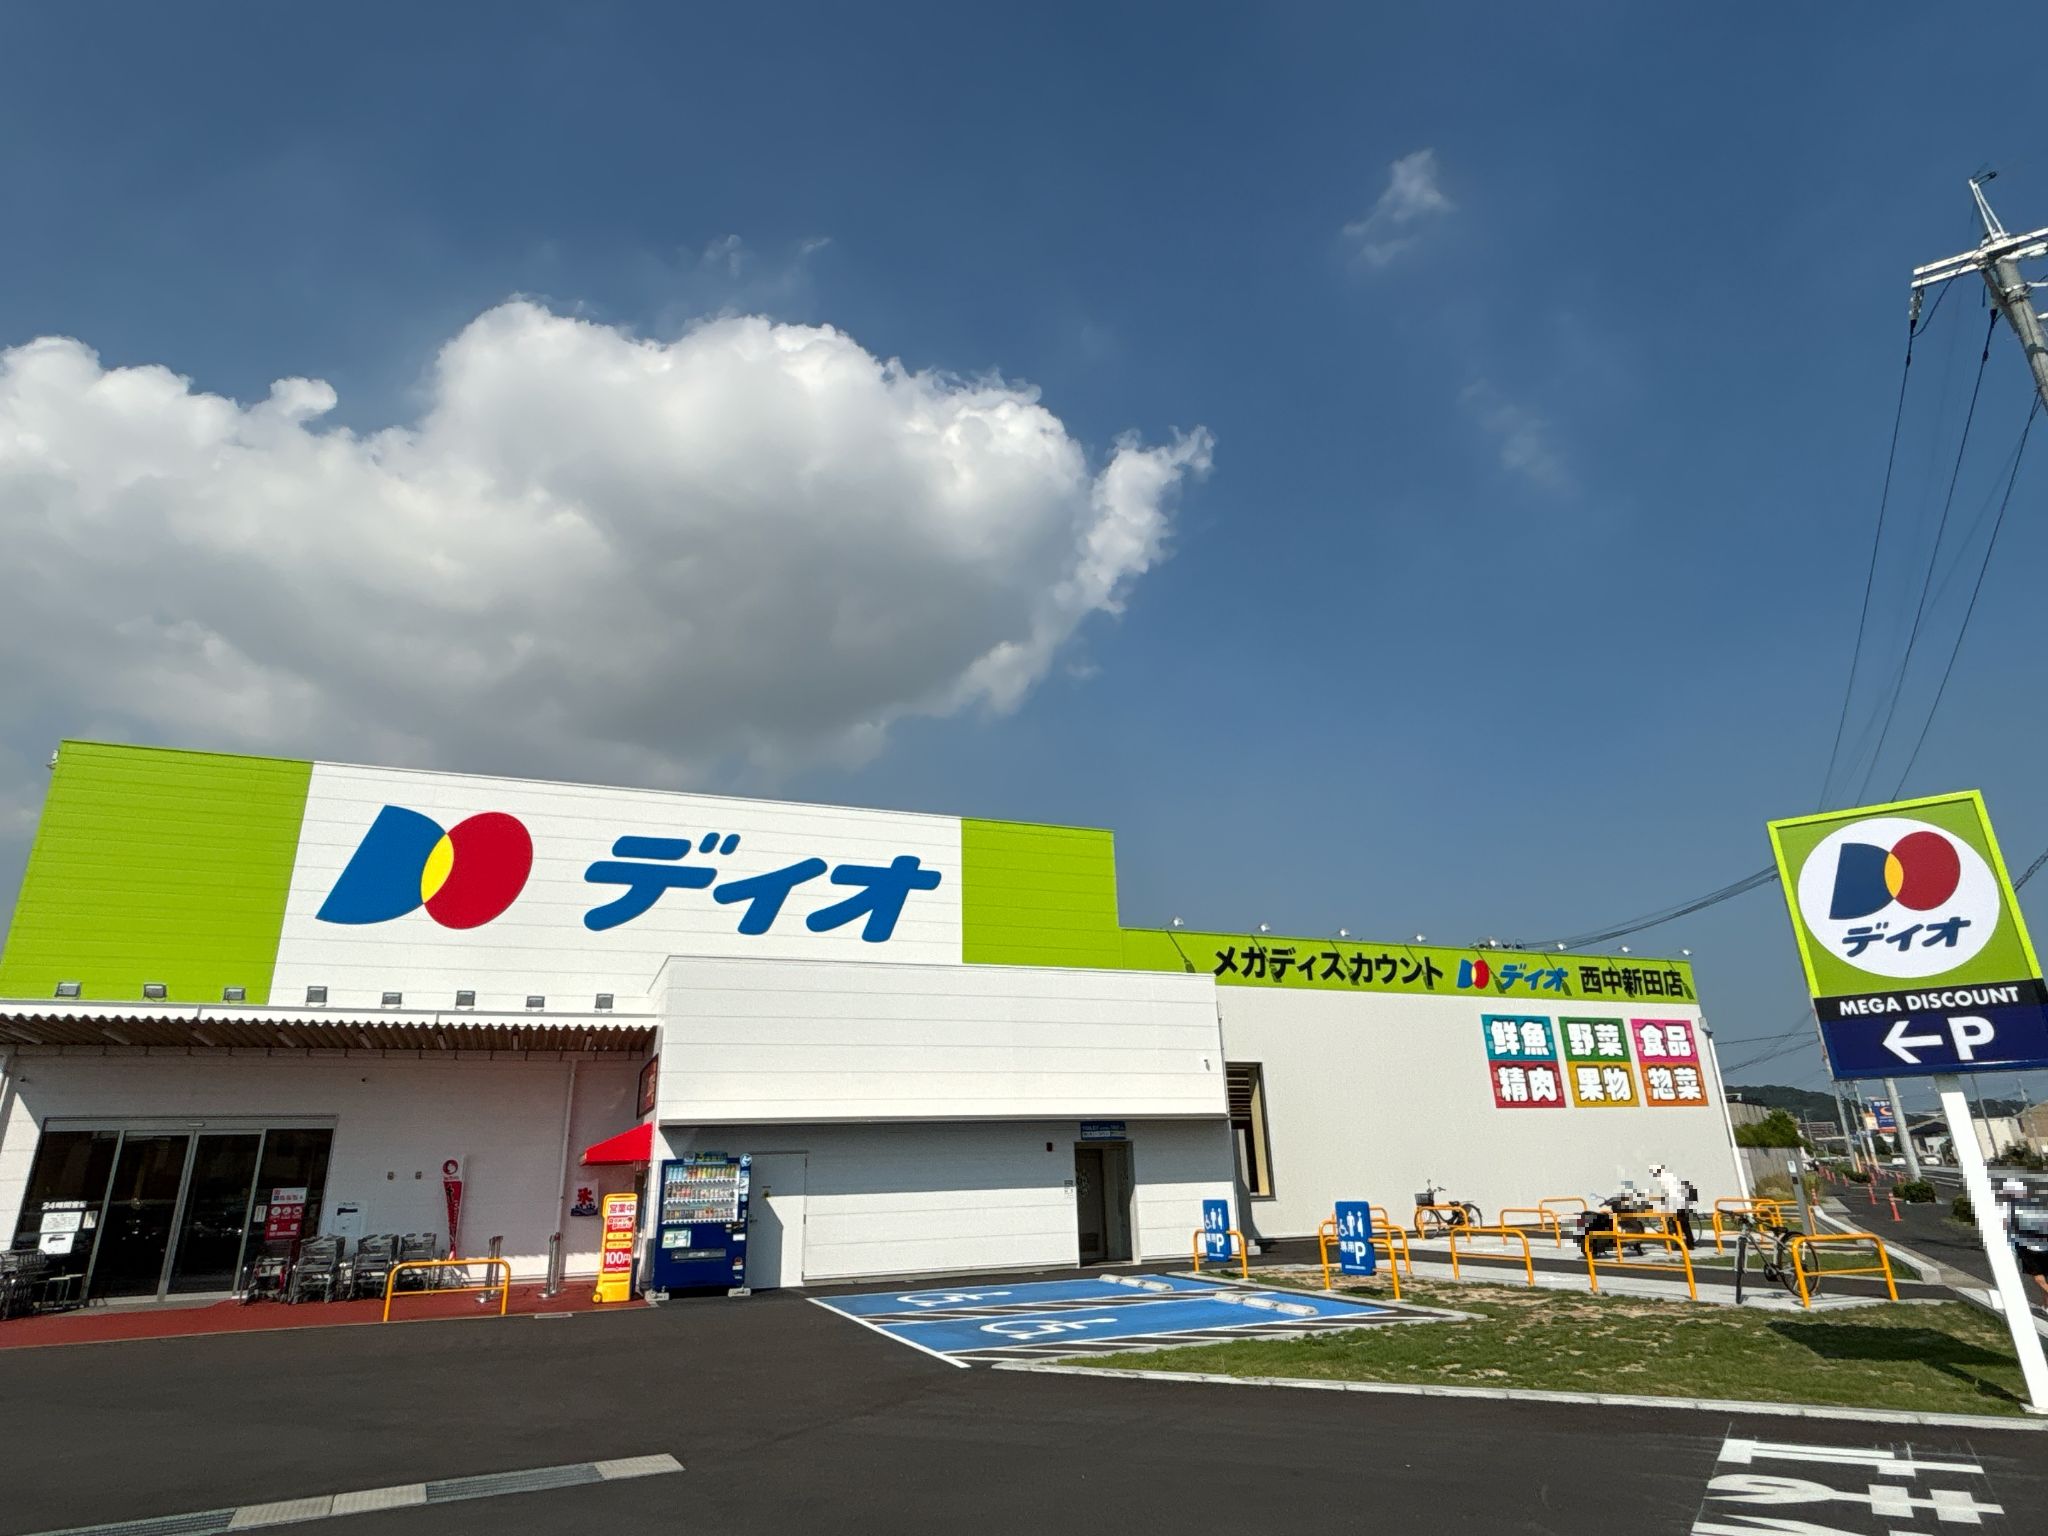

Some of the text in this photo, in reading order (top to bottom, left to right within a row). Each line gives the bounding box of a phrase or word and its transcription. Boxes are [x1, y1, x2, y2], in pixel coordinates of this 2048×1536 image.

[583, 832, 943, 944] ディオ
[1842, 916, 1971, 957] ディオ
[1214, 945, 1684, 997] メガディスカウント ディオ 西中新田店
[1840, 986, 2019, 1016] MEGA DISCOUNT
[1490, 1020, 1550, 1056] 鮮魚
[1566, 1022, 1624, 1057] 野菜
[1639, 1024, 1692, 1058] 食品
[1948, 1016, 1995, 1061] P
[1497, 1067, 1558, 1102] 精肉
[1576, 1067, 1631, 1102] 果物
[1647, 1066, 1702, 1101] 惣菜
[609, 1203, 635, 1214] 営業中
[1355, 1241, 1366, 1264] P
[1690, 1438, 2005, 1536] 止ま
